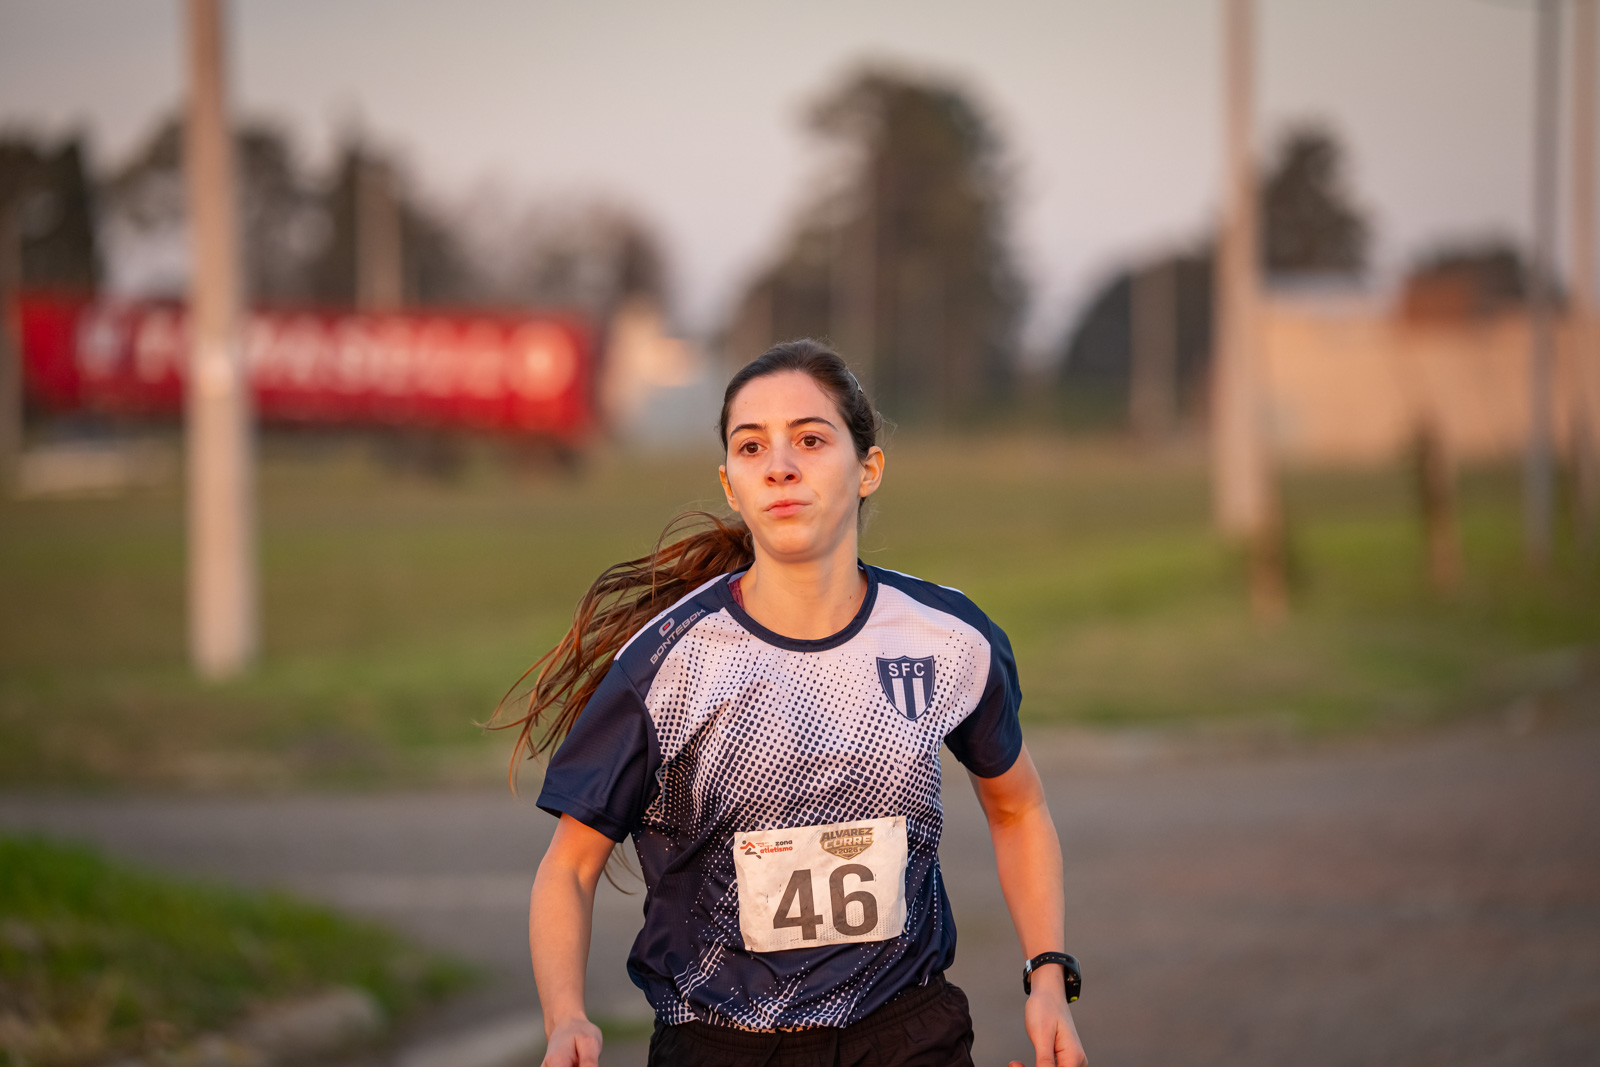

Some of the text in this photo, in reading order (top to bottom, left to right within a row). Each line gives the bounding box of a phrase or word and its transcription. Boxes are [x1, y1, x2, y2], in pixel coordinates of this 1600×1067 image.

[650, 609, 706, 664] BONTEBOK
[888, 662, 925, 677] SFC
[821, 827, 874, 842] ALVAREZ
[760, 846, 793, 854] atletismo
[823, 836, 872, 850] CORRE
[773, 863, 878, 940] 46
